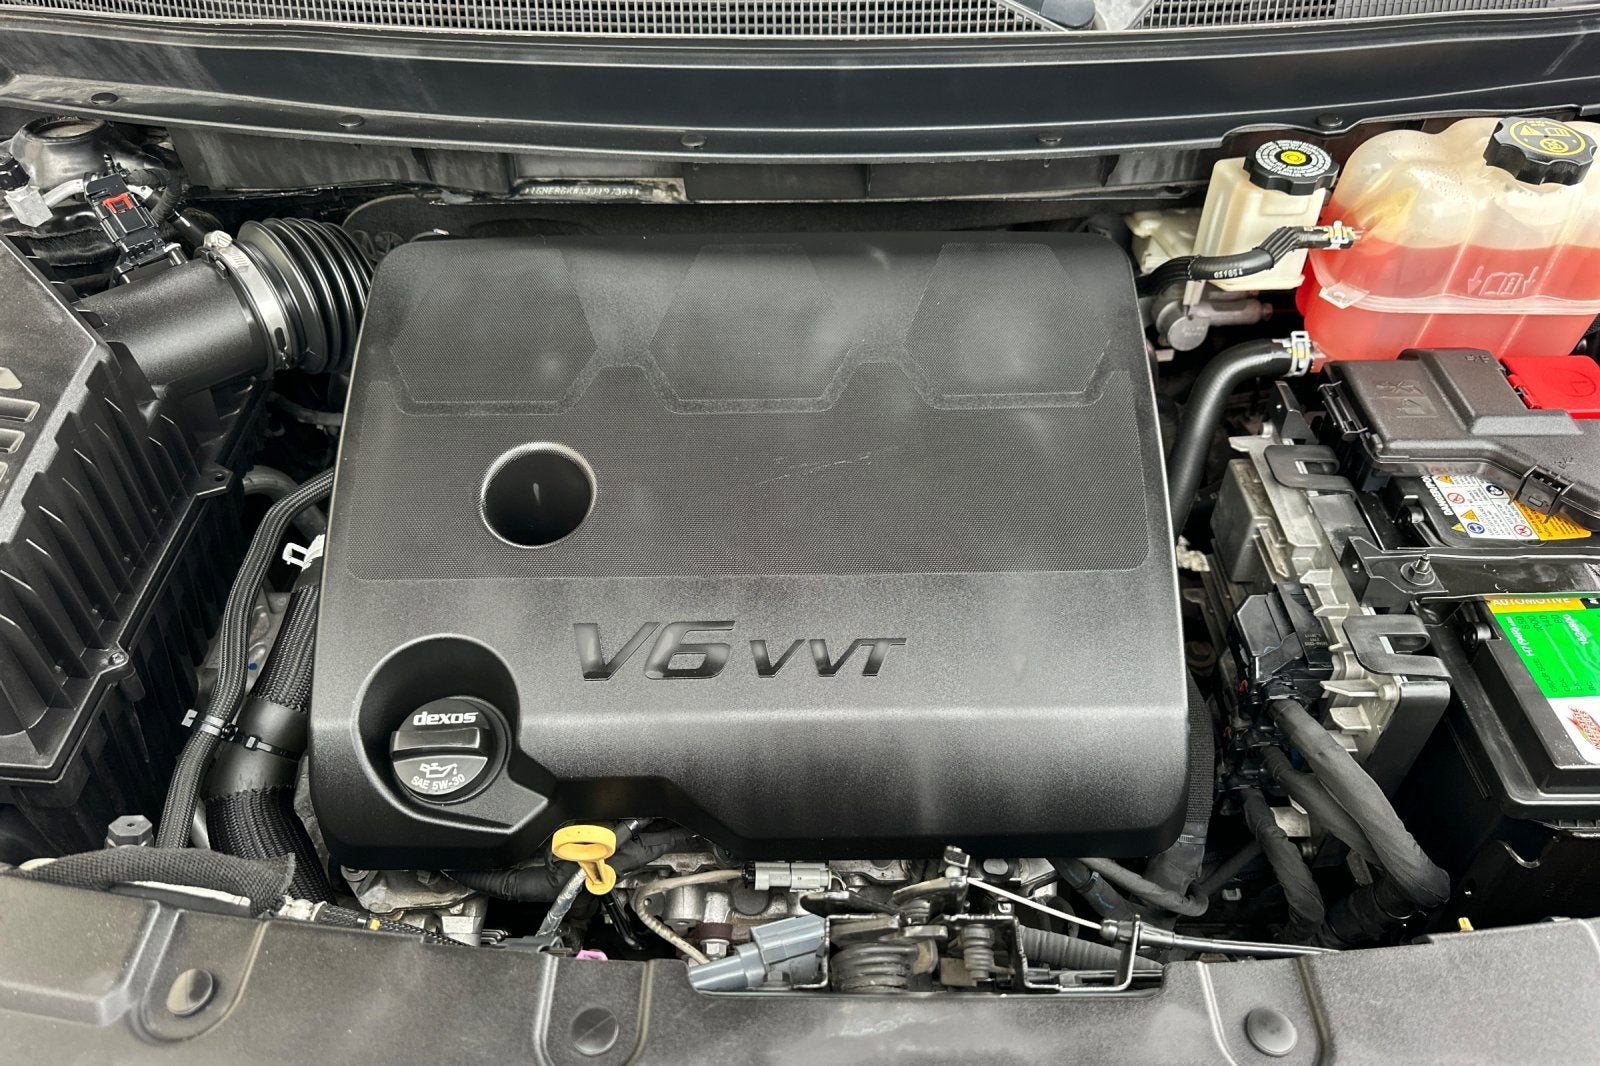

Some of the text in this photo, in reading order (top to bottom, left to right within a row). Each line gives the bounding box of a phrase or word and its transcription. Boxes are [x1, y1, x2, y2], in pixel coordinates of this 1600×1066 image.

[574, 620, 907, 681] V6 VVT
[413, 711, 479, 726] dexos
[411, 773, 466, 790] SAE 5W-30
